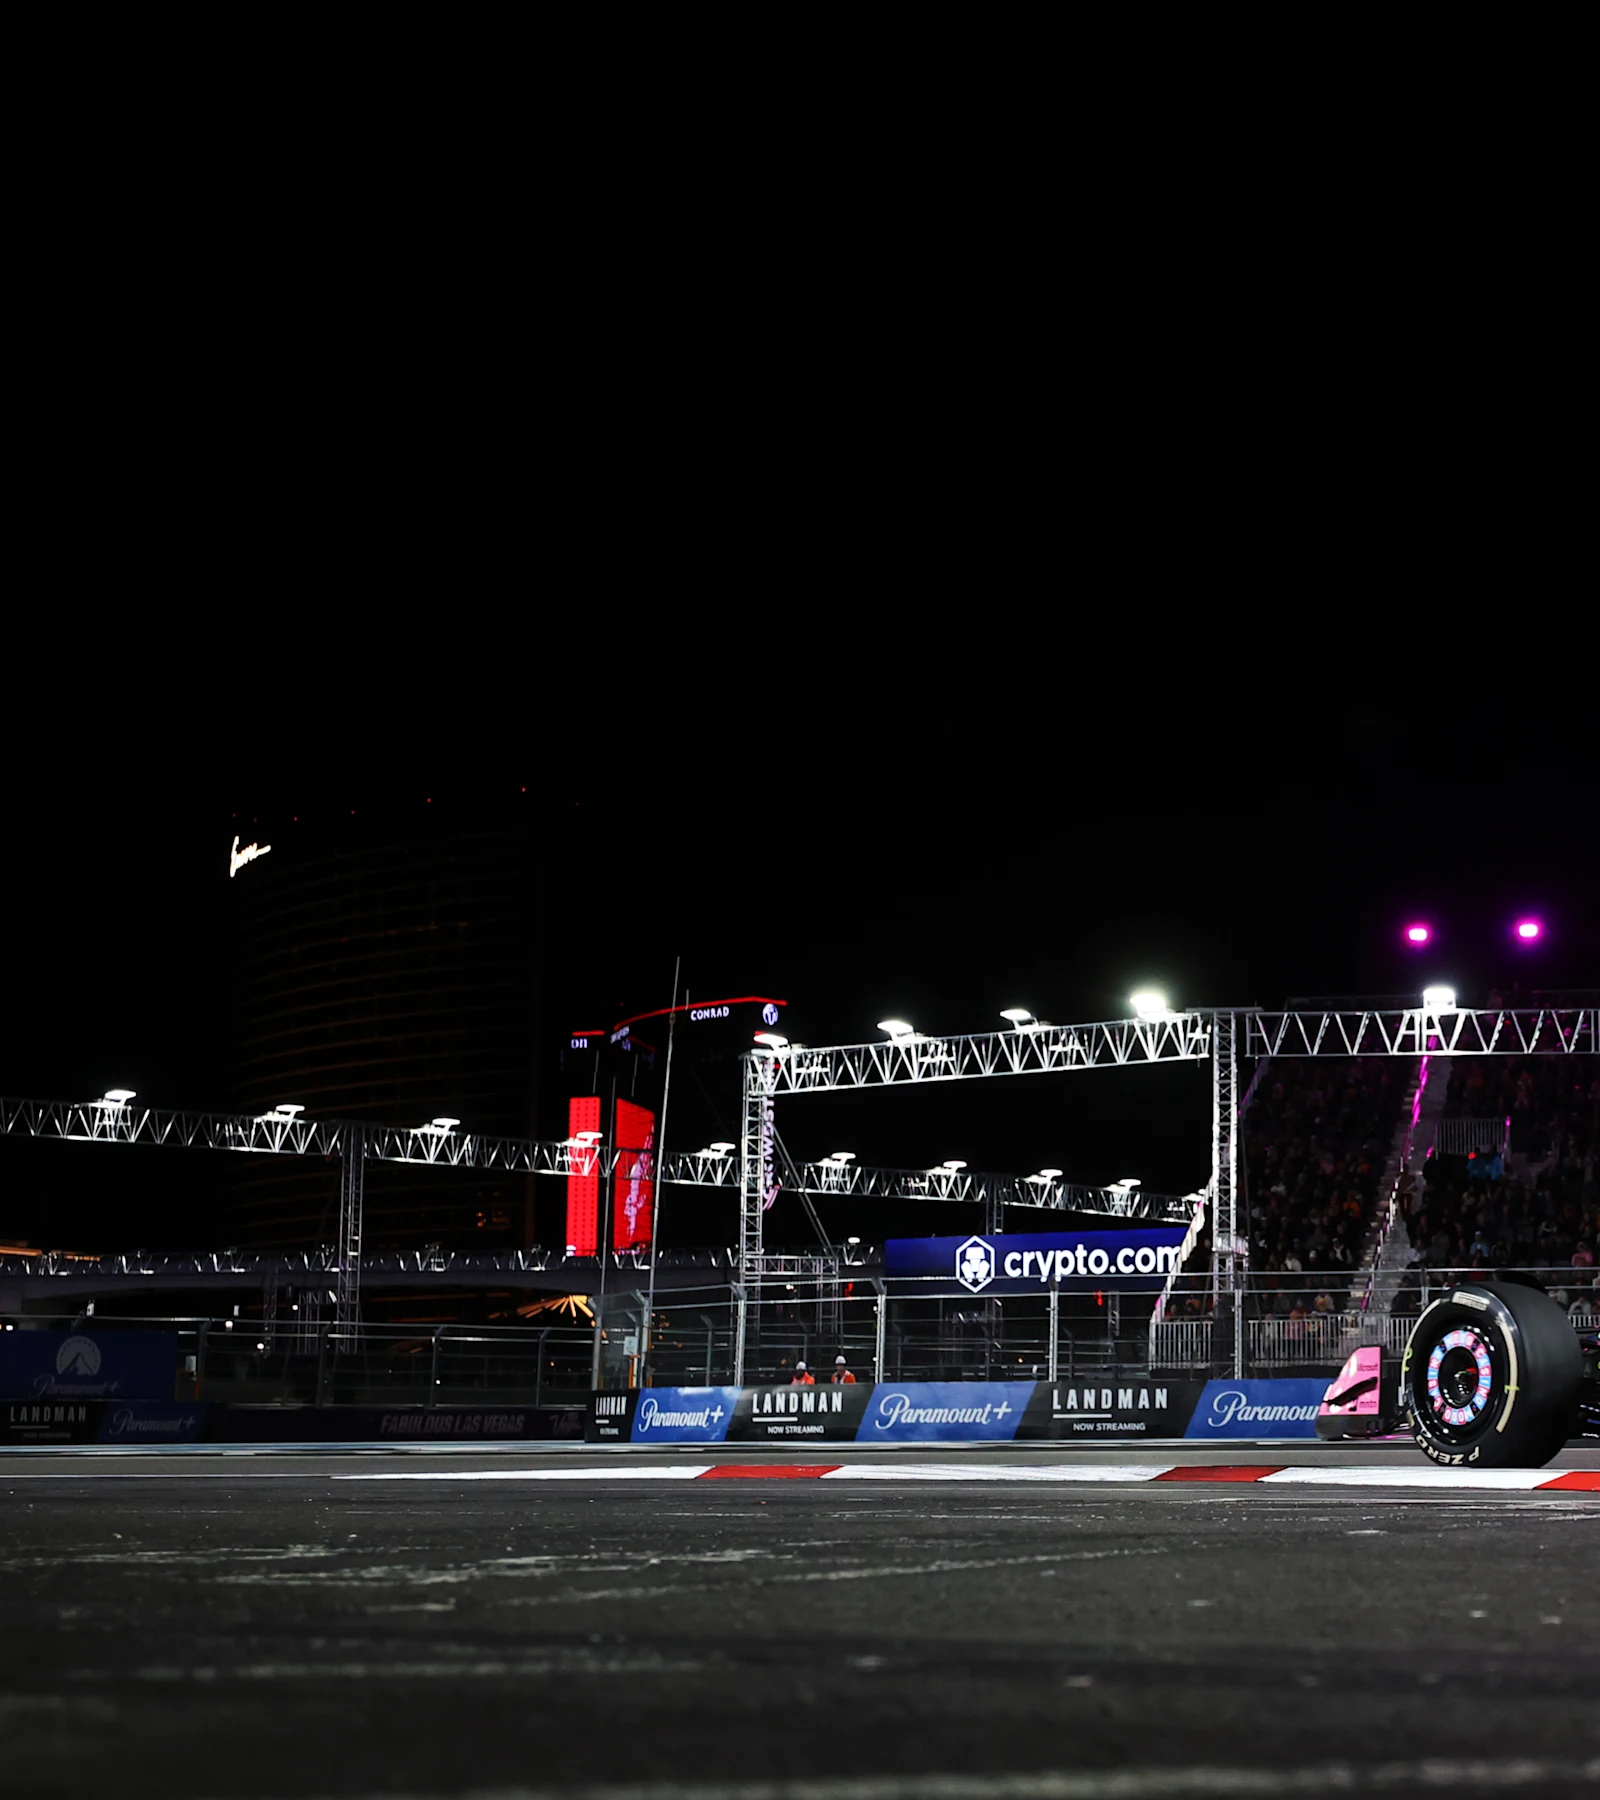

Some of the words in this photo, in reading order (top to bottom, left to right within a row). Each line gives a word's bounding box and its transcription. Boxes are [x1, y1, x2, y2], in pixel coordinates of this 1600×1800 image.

[690, 1006, 730, 1021] CONRAD
[1003, 1243, 1181, 1282] crypto.com
[28, 1374, 121, 1397] Paramount+
[752, 1392, 842, 1414] LANDMAN
[1052, 1388, 1168, 1411] LANDMAN
[9, 1405, 87, 1423] LANDMAN
[108, 1408, 196, 1436] Paramount+
[638, 1398, 724, 1432] Paramount+
[875, 1393, 1012, 1430] Paramount+
[380, 1414, 452, 1435] FABULOUS
[453, 1414, 481, 1434] LAS
[482, 1413, 526, 1434] VEGAS
[767, 1426, 785, 1434] NOW
[785, 1425, 825, 1434] STREAMING
[1073, 1423, 1095, 1432] NOW
[1096, 1422, 1146, 1432] STREAMING
[1415, 1433, 1465, 1466] ZERO
[1467, 1445, 1480, 1462] P
